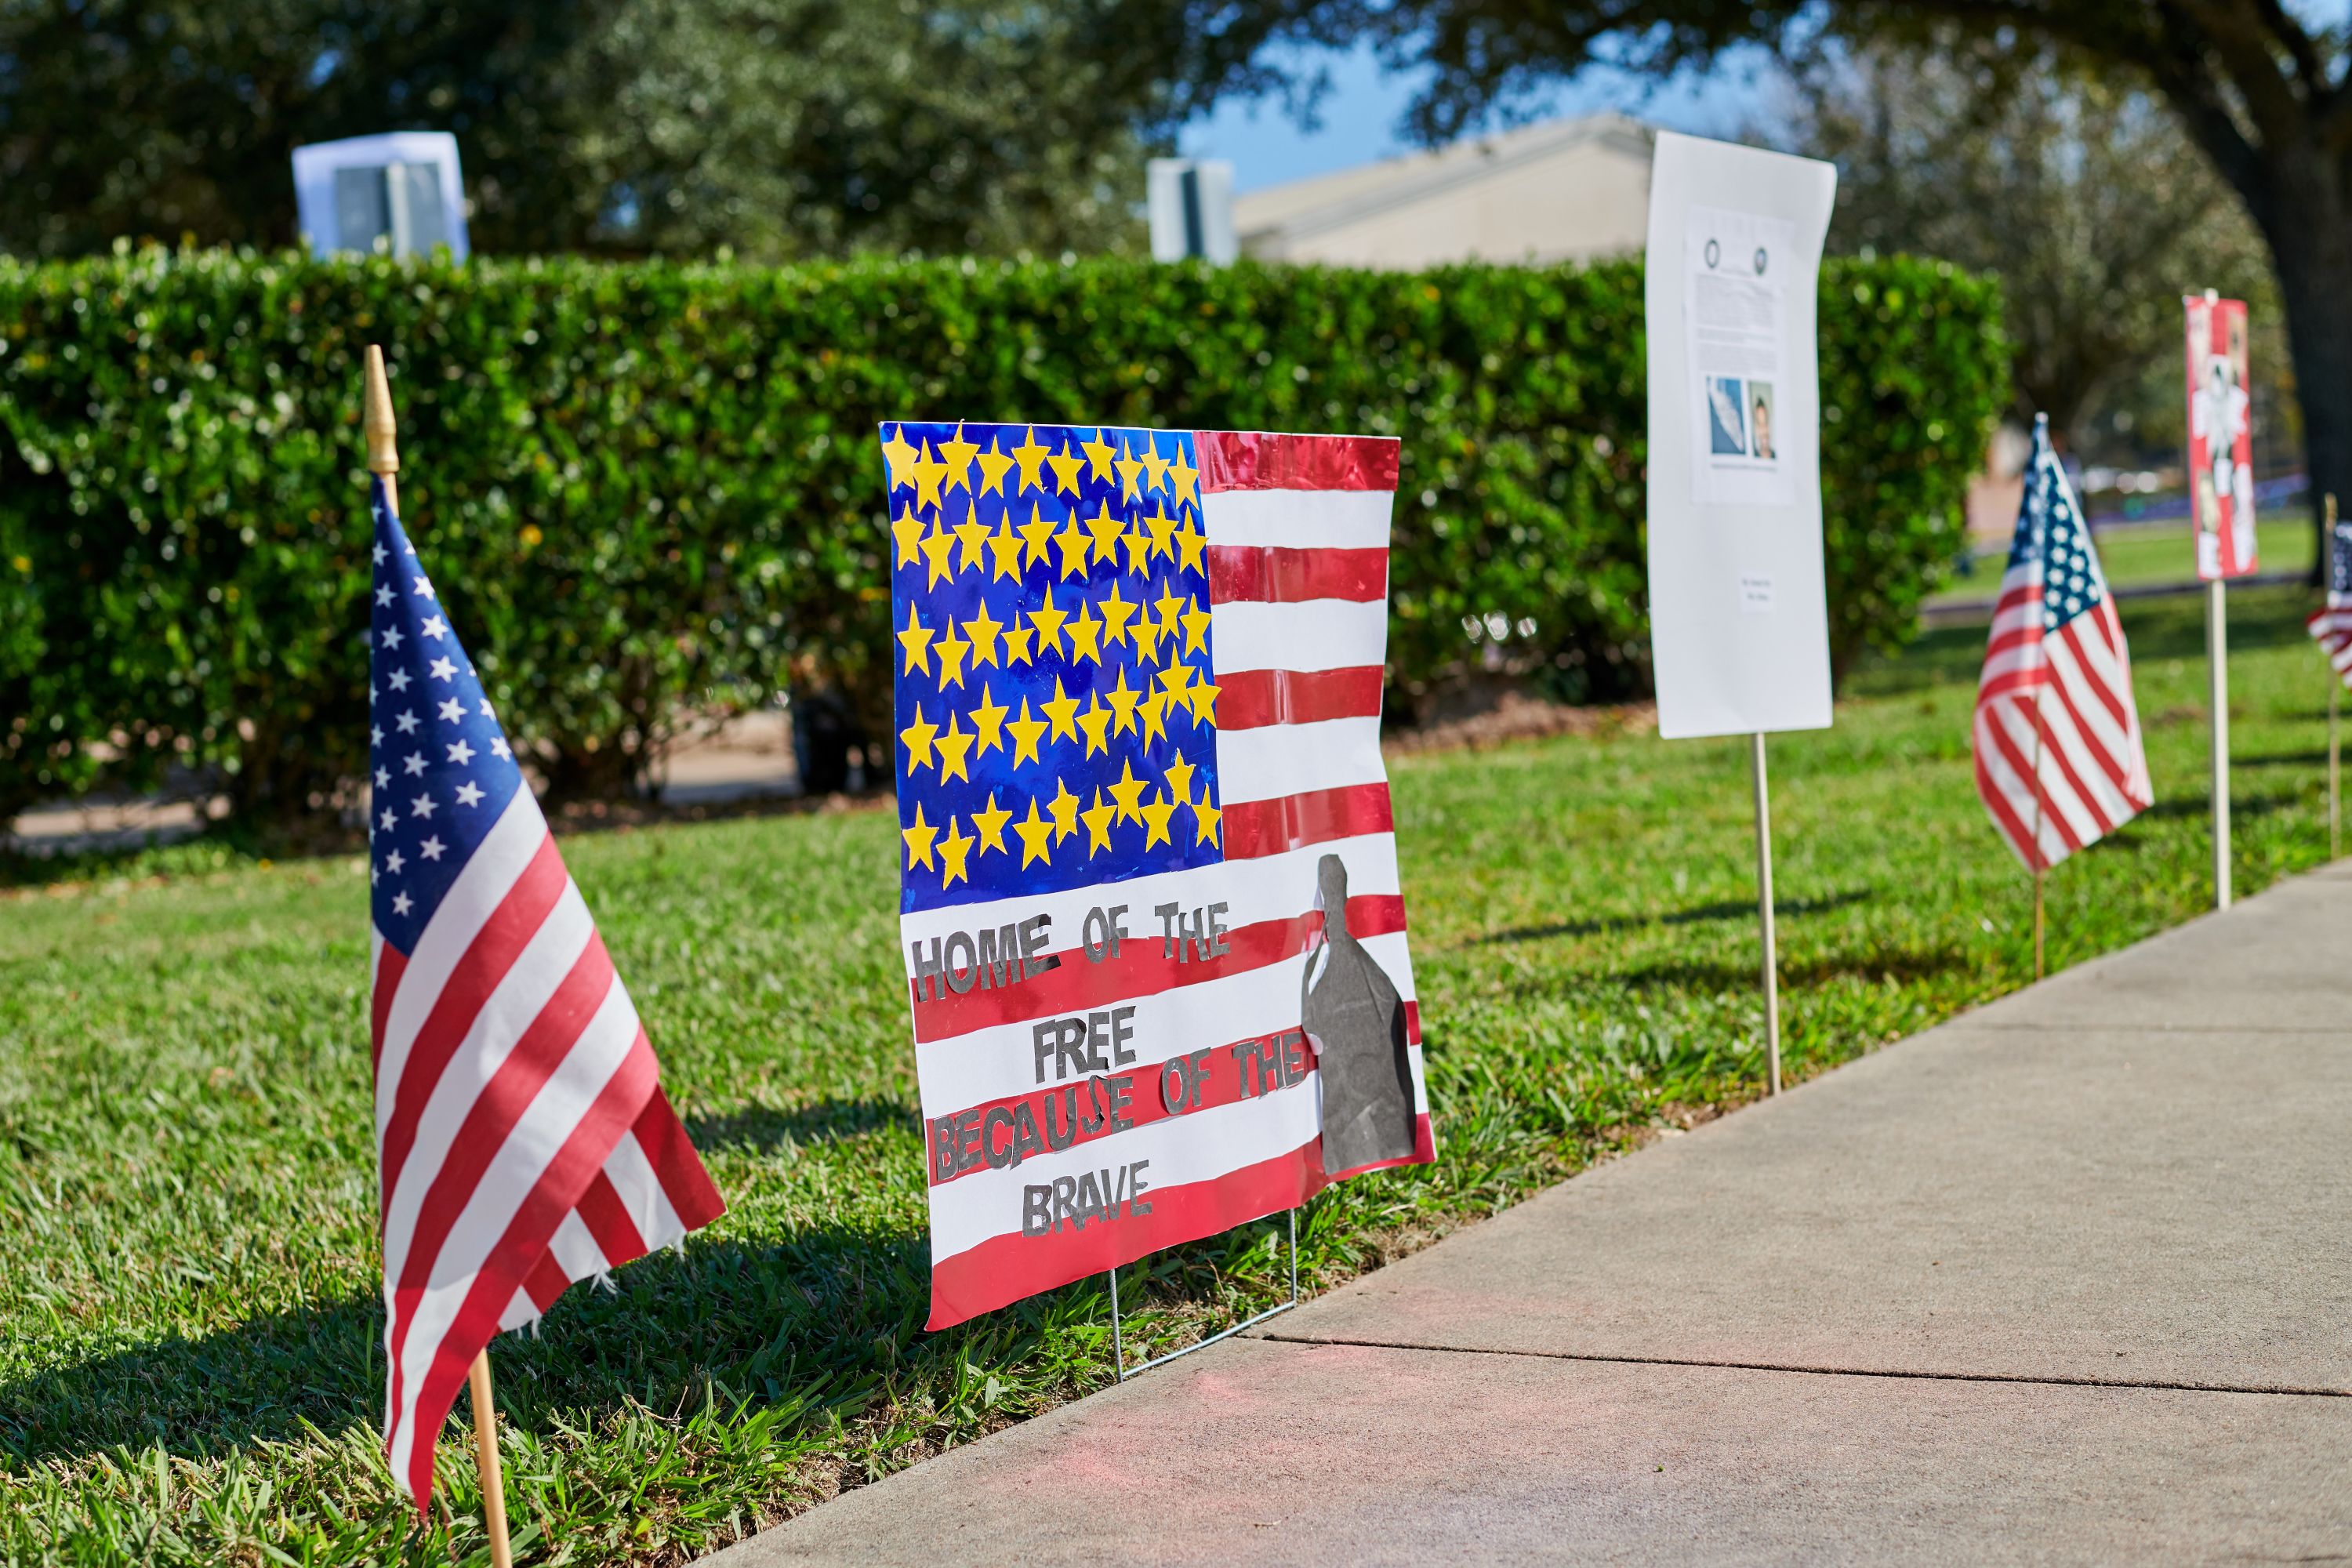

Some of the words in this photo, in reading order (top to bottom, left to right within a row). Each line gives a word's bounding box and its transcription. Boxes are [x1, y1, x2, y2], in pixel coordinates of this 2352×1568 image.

[912, 913, 1061, 1002] HOME
[1082, 905, 1128, 964] OF
[1155, 902, 1230, 964] THE
[1033, 1006, 1137, 1084] FREE
[933, 1075, 1134, 1182] BECAUSE
[1161, 1047, 1211, 1116] OF
[1232, 1032, 1305, 1100] THE
[1022, 1160, 1152, 1237] BRAVE
